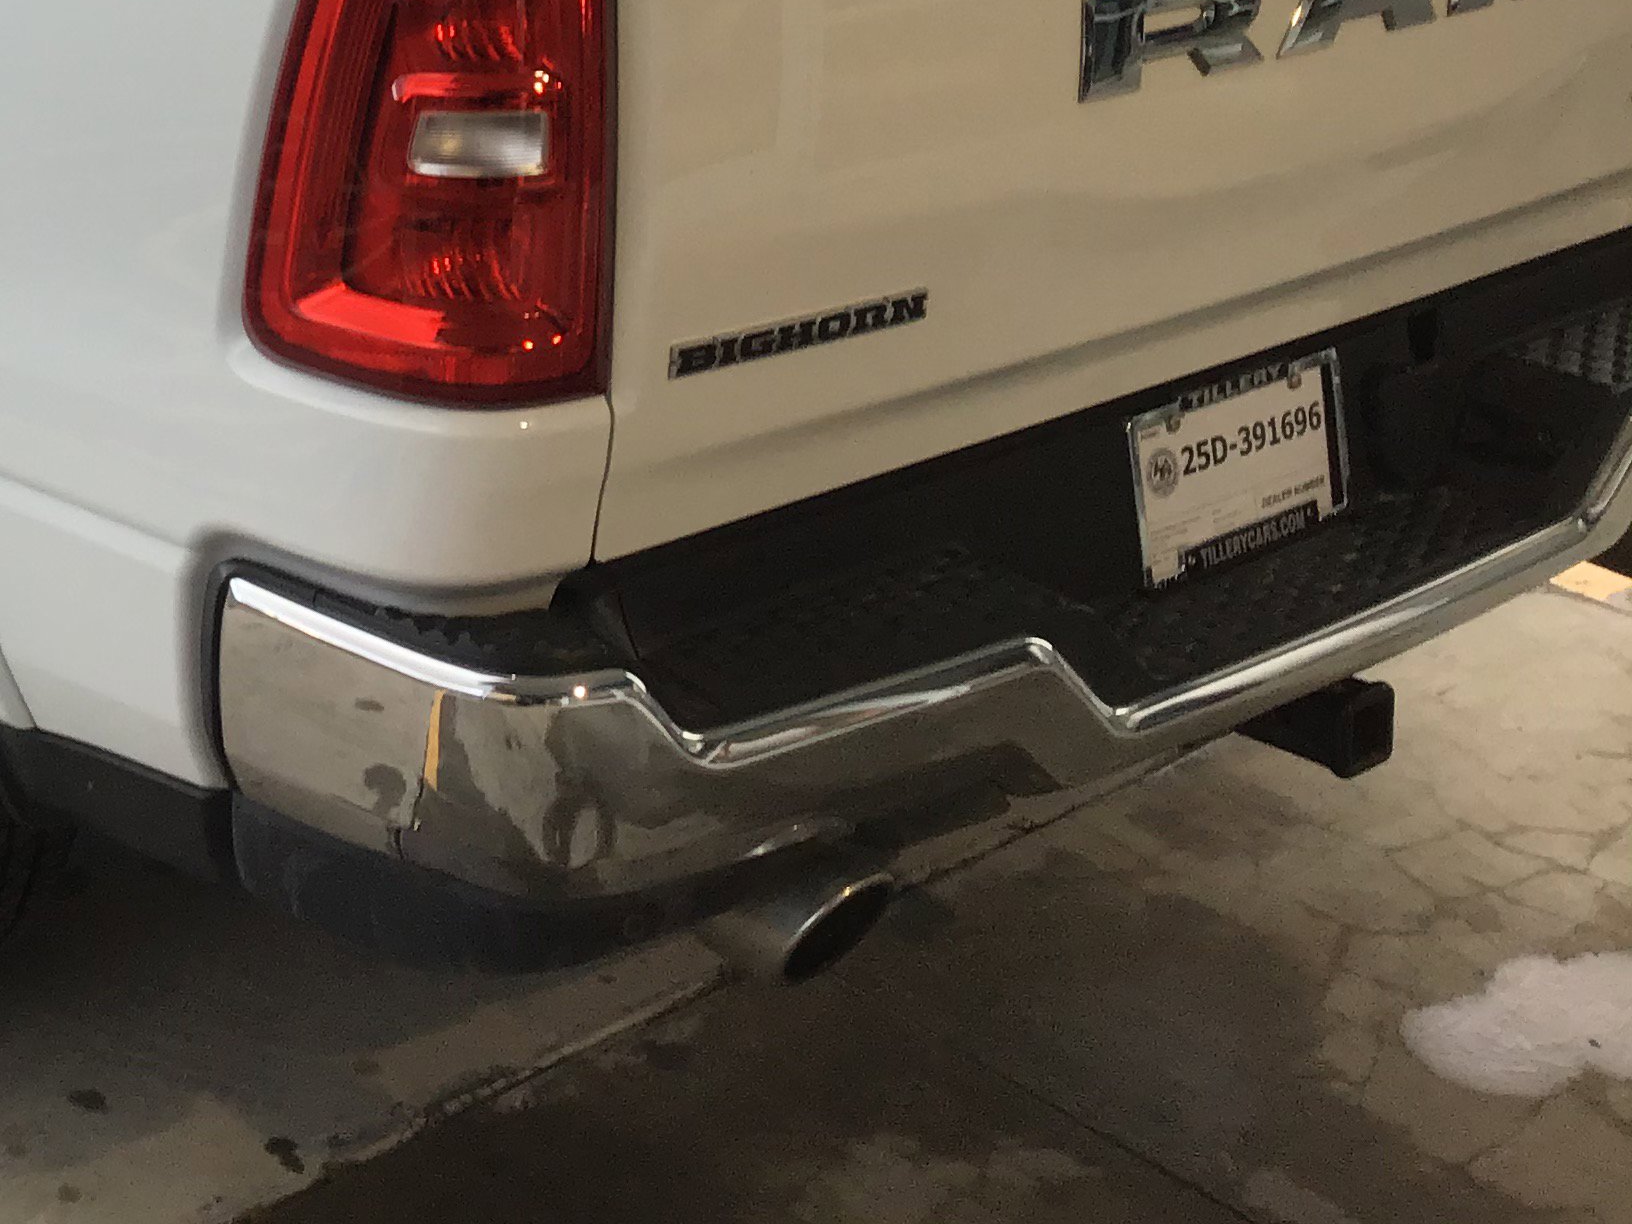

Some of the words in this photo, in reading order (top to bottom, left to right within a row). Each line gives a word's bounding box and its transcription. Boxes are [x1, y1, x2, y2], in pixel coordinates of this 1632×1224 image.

[668, 287, 928, 380] BIGHORN
[1188, 363, 1283, 409] TILLERY
[1180, 400, 1323, 476] 25D-391696
[1200, 510, 1306, 569] TILLERYCARS.COM
